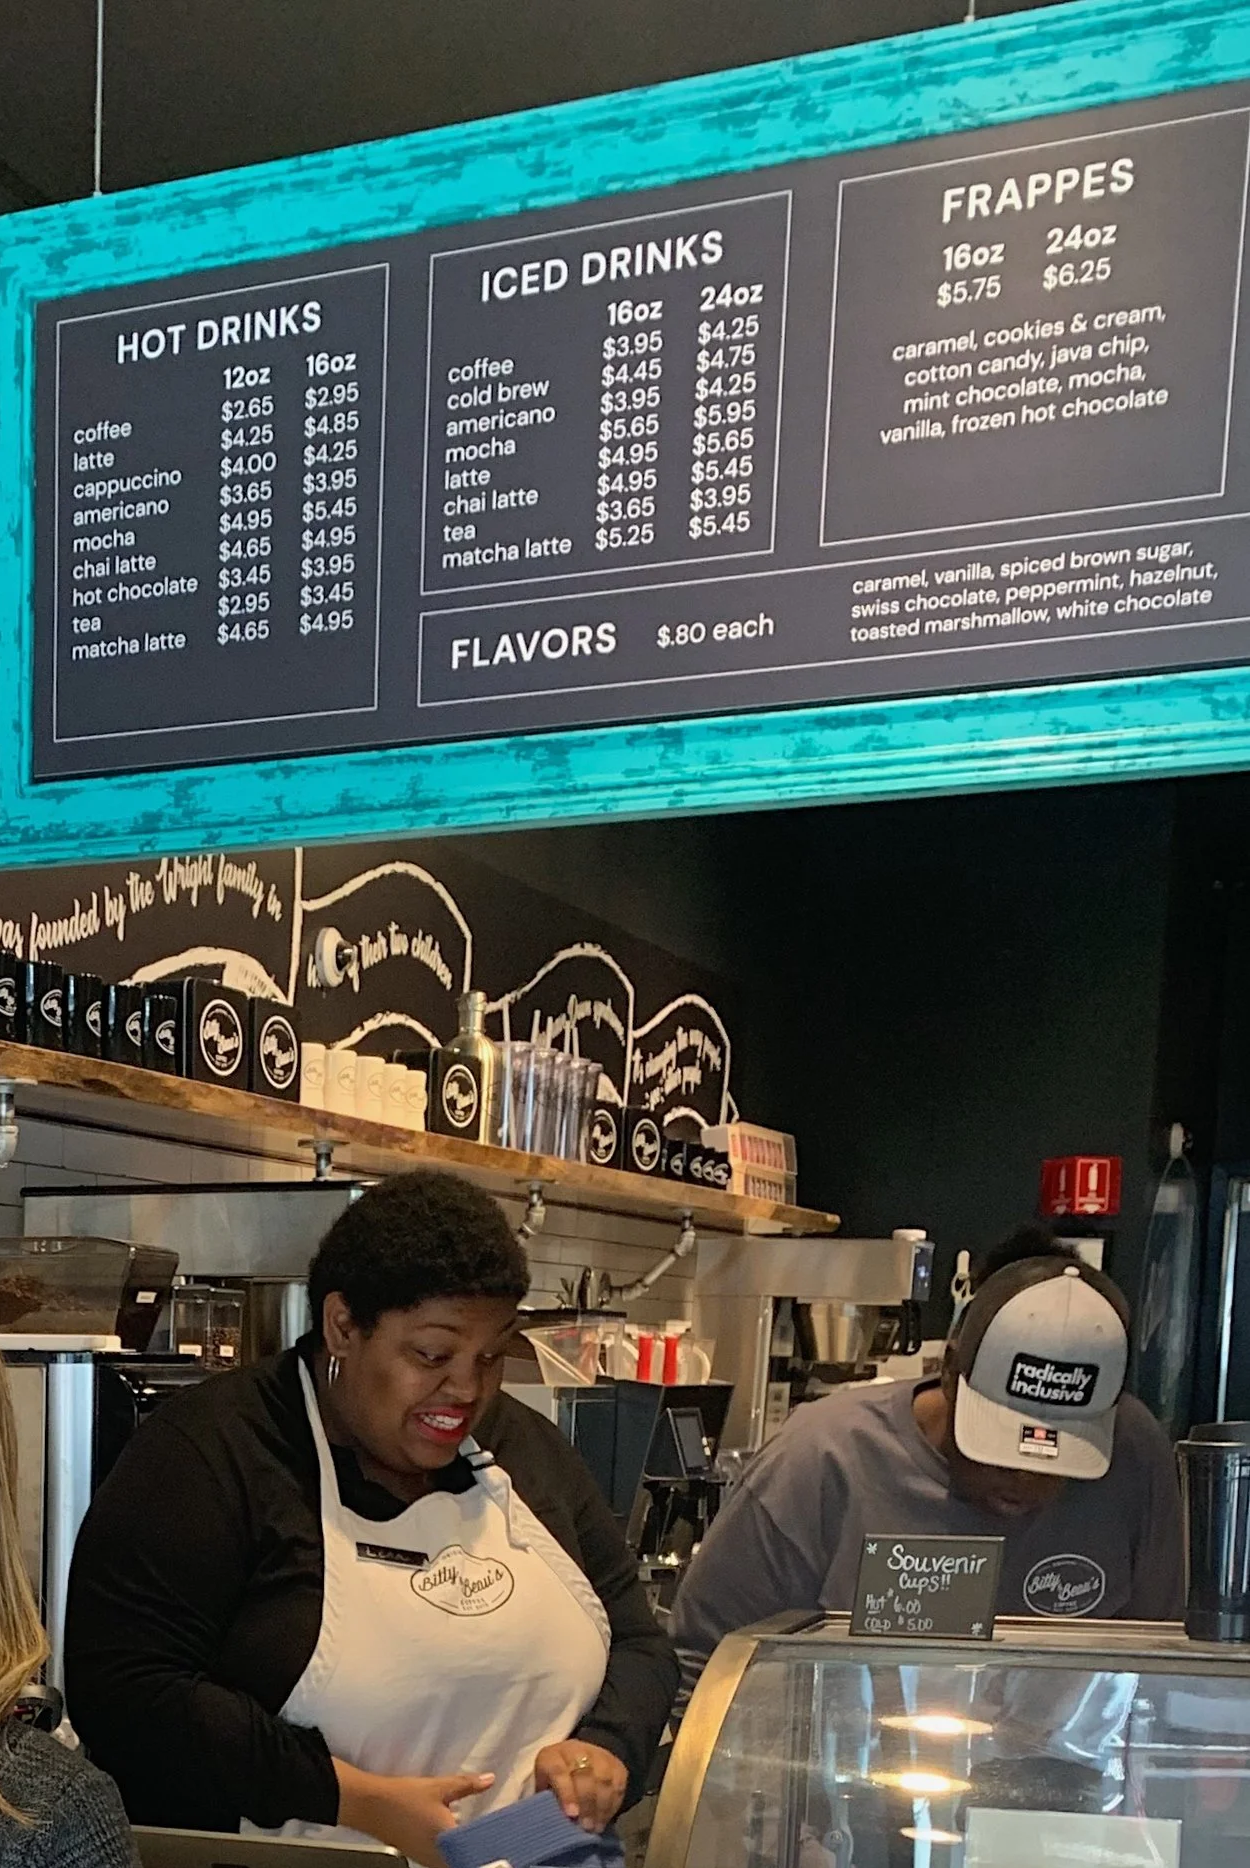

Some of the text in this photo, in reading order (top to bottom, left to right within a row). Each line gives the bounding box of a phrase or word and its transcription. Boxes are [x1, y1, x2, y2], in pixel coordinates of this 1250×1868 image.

[943, 158, 1133, 223] FRAPPES
[482, 231, 722, 302] ICED DRINKS
[943, 224, 1117, 271] 16oz 24oz
[608, 283, 763, 326] 16oz 24oz
[937, 257, 1111, 308] $5.75 $6.25
[118, 301, 321, 364] HOT DRINKS
[448, 315, 759, 383] coffee $3.95 $4.25
[893, 306, 1166, 361] caramel, cookies & cream,
[905, 333, 1149, 386] cotton candy, java chip,
[224, 353, 356, 389] 12oz 16oz
[447, 343, 755, 410] cold brew $4.45 $4.75
[904, 363, 1146, 414] mint chocolate, mocha,
[74, 382, 359, 444] coffee $2.65 $2.95
[446, 371, 756, 437] americano $3.95 $4.25
[446, 399, 755, 463] mocha $5.65 $5.95
[880, 389, 1168, 444] vanilla, frozen hot chocolate
[74, 411, 359, 472] latte $4.25 $4.85
[445, 427, 754, 490] latte $4.95 $5.65
[73, 468, 357, 526] americano $3.65 $3.95
[74, 439, 357, 501] cappuccino $4.00 $4.25
[444, 455, 753, 516] chai latte $4.95 $5.45
[73, 496, 357, 553] mocha $4.95 $5.45
[443, 483, 751, 542] tea $3.65 $3.95
[443, 511, 750, 568] matcha latte $5.25 $5.45
[73, 525, 355, 579] chai latte $4.65 $4.95
[853, 542, 1193, 594] caramel, vanilla, spiced brown sugar,
[73, 553, 354, 607] hot chocolate $3.45 $3.95
[73, 581, 354, 633] tea $2.95 $3.45
[851, 563, 1218, 618] swiss chocolate, peppermint, hazelnut,
[72, 609, 353, 660] matcha latte $4.65 $4.95
[452, 613, 774, 669] FLAVORS $.80 each
[851, 589, 1212, 642] toasted marshmallow, white chocolate
[30, 890, 100, 962] founded
[104, 885, 126, 942] by
[126, 871, 155, 914] the
[156, 853, 214, 907] Wright
[216, 853, 264, 919] family
[267, 884, 283, 922] in
[1010, 1376, 1085, 1403] inclusive
[1015, 1360, 1093, 1388] radically
[418, 1566, 504, 1598] Bitty Beau's
[887, 1544, 988, 1574] Souvenir
[899, 1572, 951, 1595] Cups!!
[1028, 1572, 1100, 1601] Bitty Beau's
